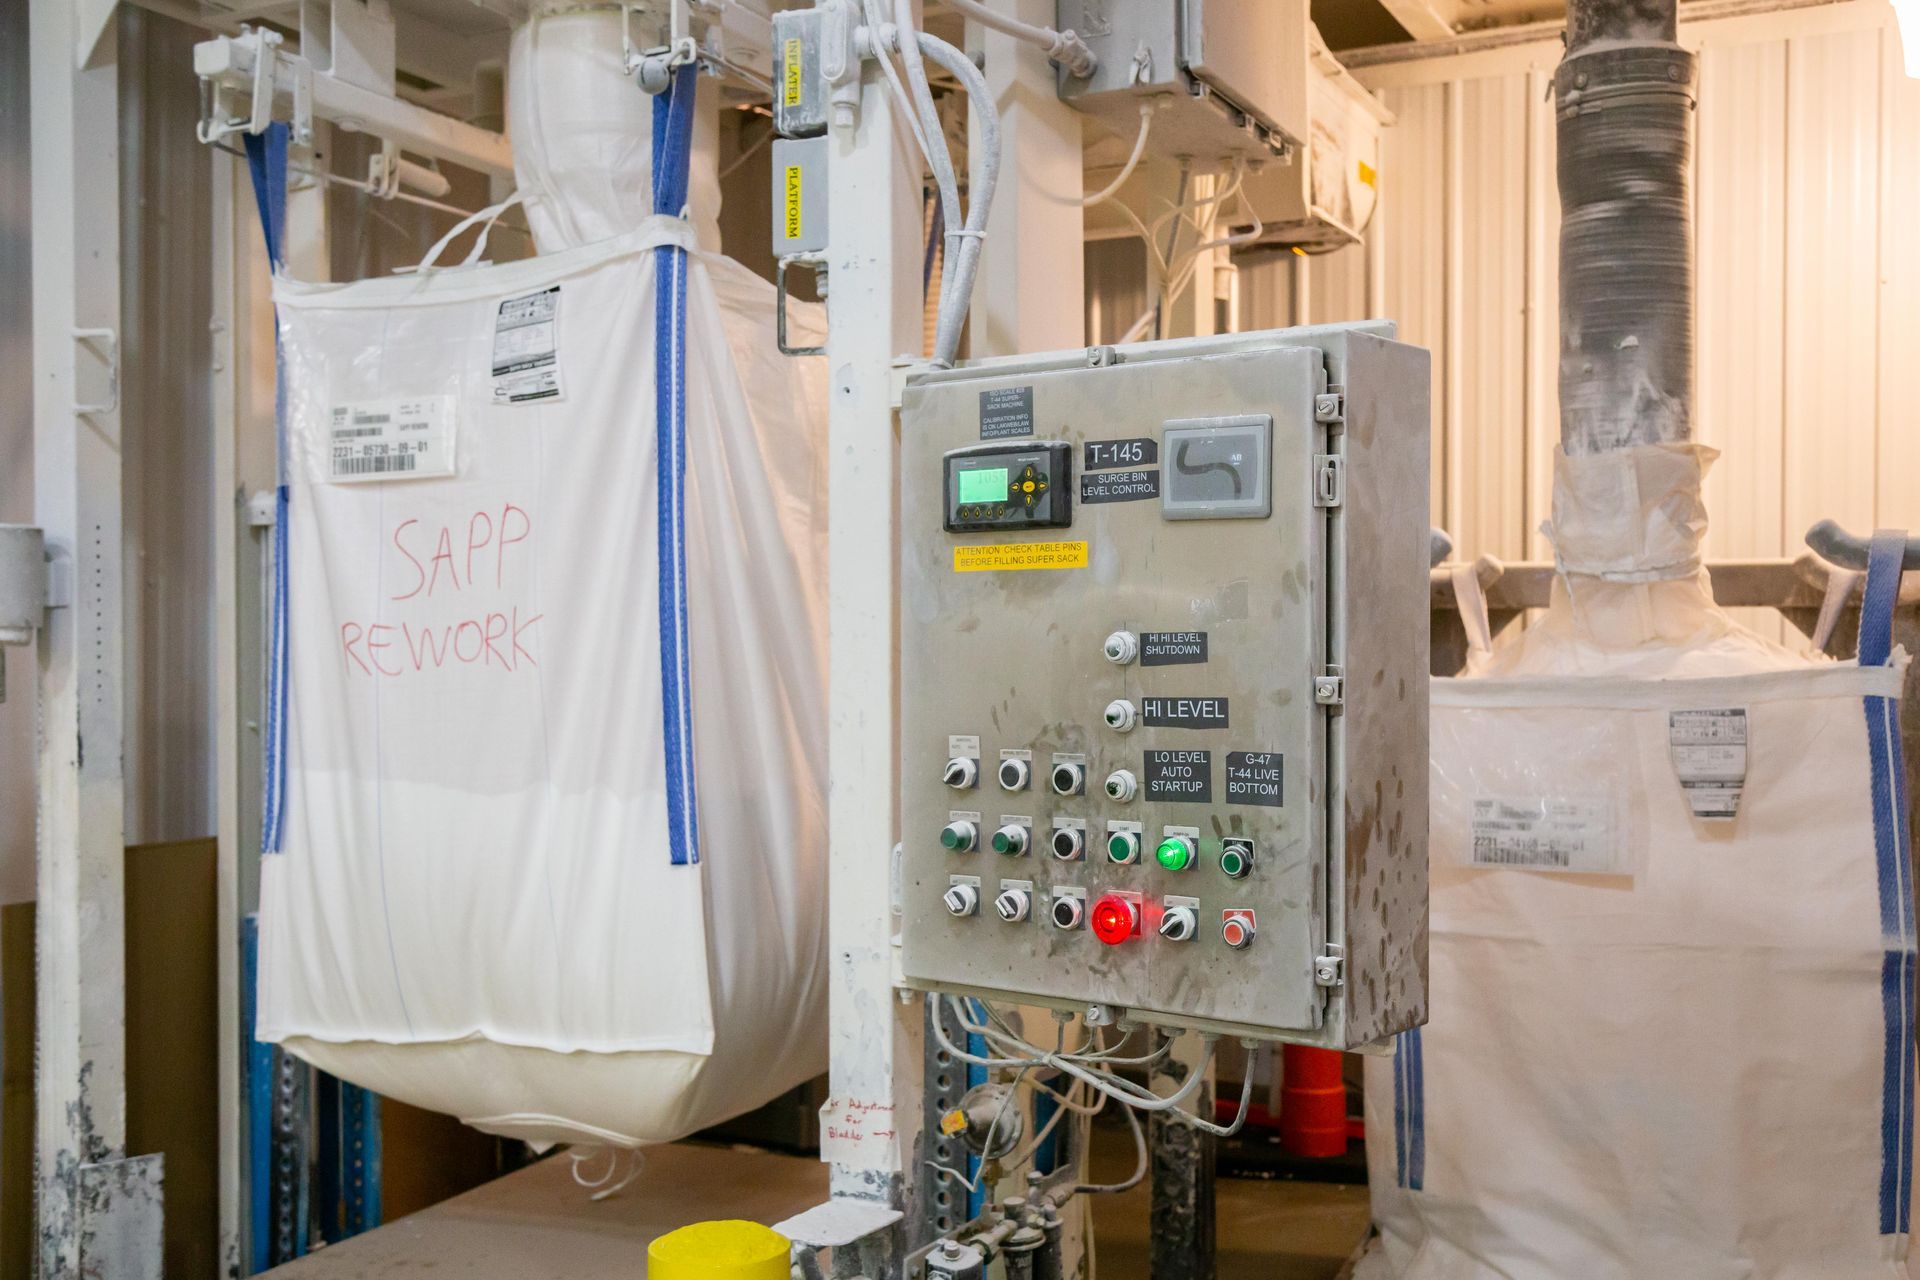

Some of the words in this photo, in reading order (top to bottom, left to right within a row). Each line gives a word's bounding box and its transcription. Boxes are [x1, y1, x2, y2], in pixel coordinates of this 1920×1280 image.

[788, 40, 798, 105] INFLATER
[788, 167, 799, 239] PLATFORM
[1001, 400, 1024, 408] MACHINE
[983, 415, 1015, 424] CALIBRATION
[1016, 413, 1029, 421] INFO
[1011, 426, 1031, 434] SCALES
[1090, 442, 1143, 463] T-145
[1098, 472, 1130, 483] SURGE
[1132, 472, 1147, 481] BIN
[1082, 486, 1110, 496] LEVEL
[1112, 484, 1156, 495] CONTROL
[392, 502, 530, 601] SAPP
[956, 546, 1001, 556] ATTENTION
[1003, 544, 1032, 554] CHECK
[1034, 543, 1060, 552] TABLE
[1062, 542, 1082, 551] PINS
[960, 558, 992, 566] BEFORE
[994, 556, 1024, 565] FILLING
[1026, 554, 1055, 564] SUPER
[1057, 554, 1079, 562] SACK
[341, 605, 544, 677] REWORK
[1149, 634, 1159, 642] HI
[1161, 634, 1170, 642] HI
[1173, 632, 1202, 642] LEVEL
[1146, 645, 1200, 655] SHUTDOWN
[1144, 700, 1162, 718] HI
[1167, 700, 1225, 718] LEVEL
[1155, 752, 1169, 763] LO
[1172, 751, 1207, 763] LEVEL
[1245, 753, 1271, 765] G-47
[1161, 766, 1192, 777] AUTO
[1228, 767, 1251, 778] T-44
[1254, 768, 1280, 780] LIVE
[1151, 780, 1203, 792] STARTUP
[1229, 782, 1278, 795] BOTTOM
